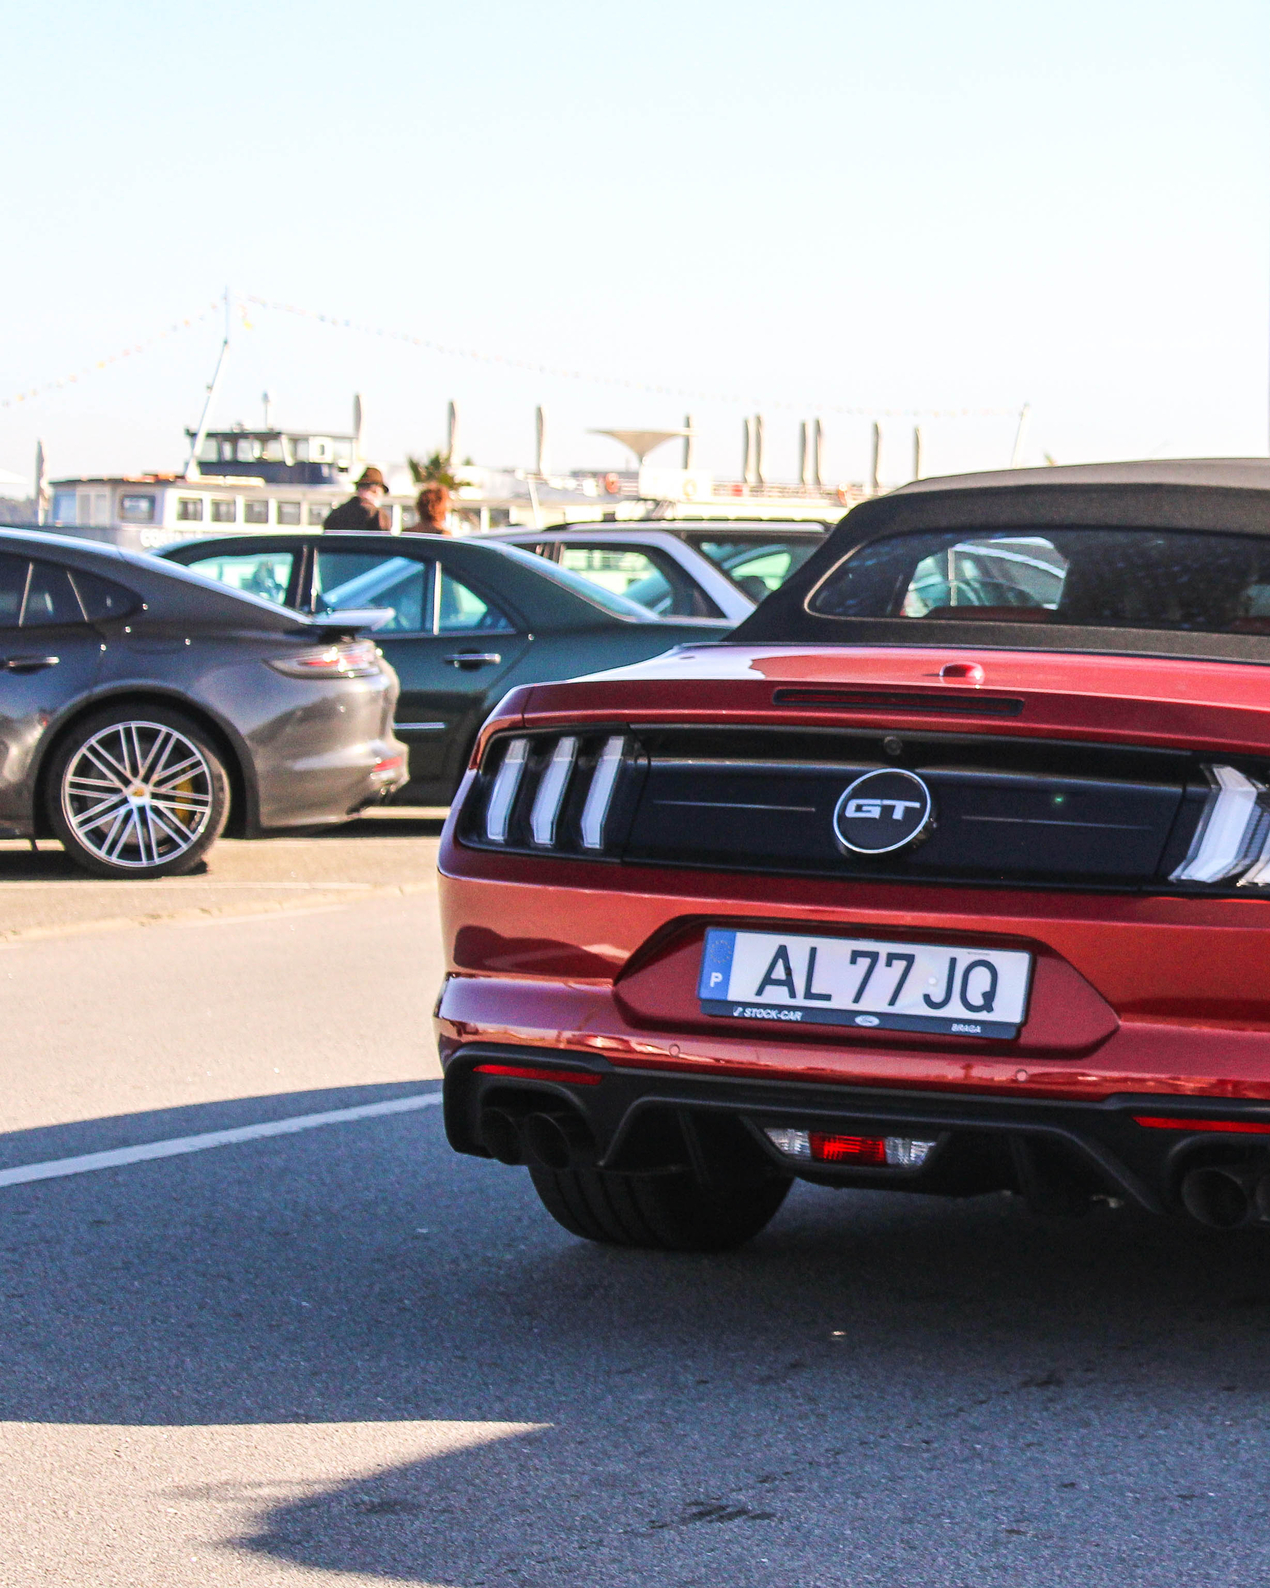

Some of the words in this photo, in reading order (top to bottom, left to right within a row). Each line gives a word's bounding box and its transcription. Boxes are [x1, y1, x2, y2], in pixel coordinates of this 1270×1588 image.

[845, 799, 920, 820] GT
[709, 972, 723, 988] P
[743, 1007, 803, 1021] STOCK-CAR
